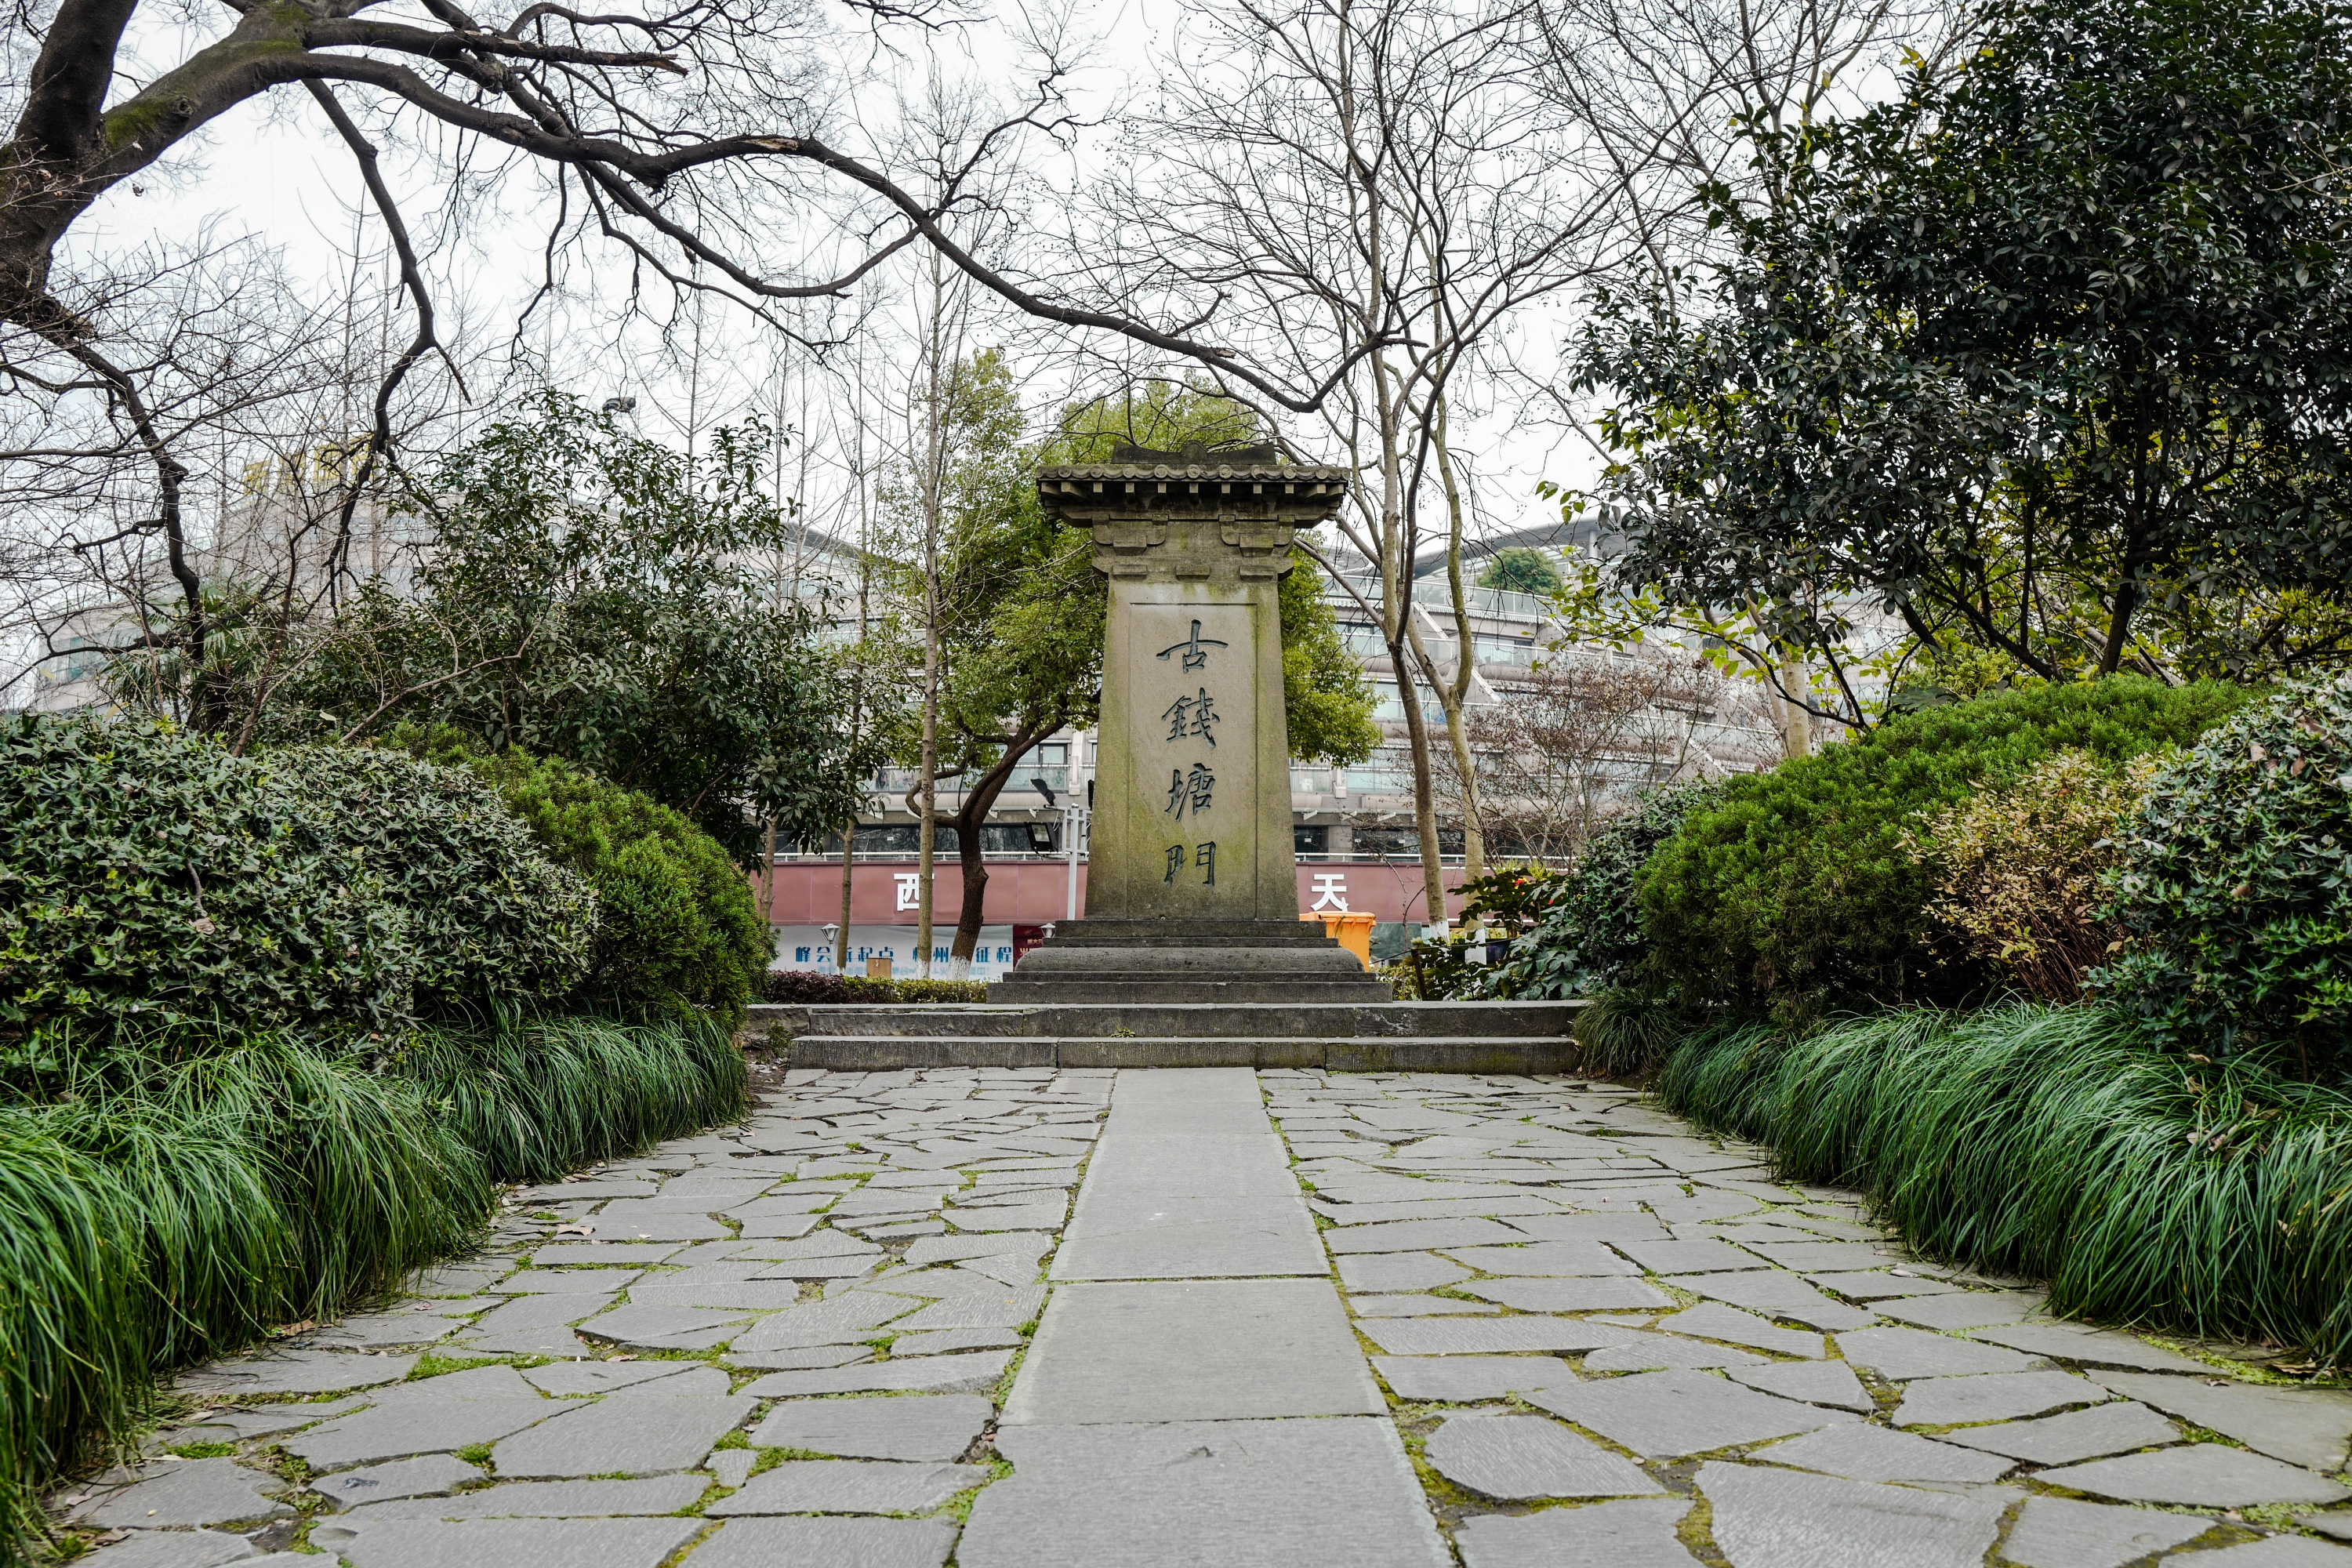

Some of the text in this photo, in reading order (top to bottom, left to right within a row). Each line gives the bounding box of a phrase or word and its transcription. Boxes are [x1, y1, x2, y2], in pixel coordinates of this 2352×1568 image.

[893, 873, 1348, 912] 西 天
[912, 946, 1012, 964] 州征程
